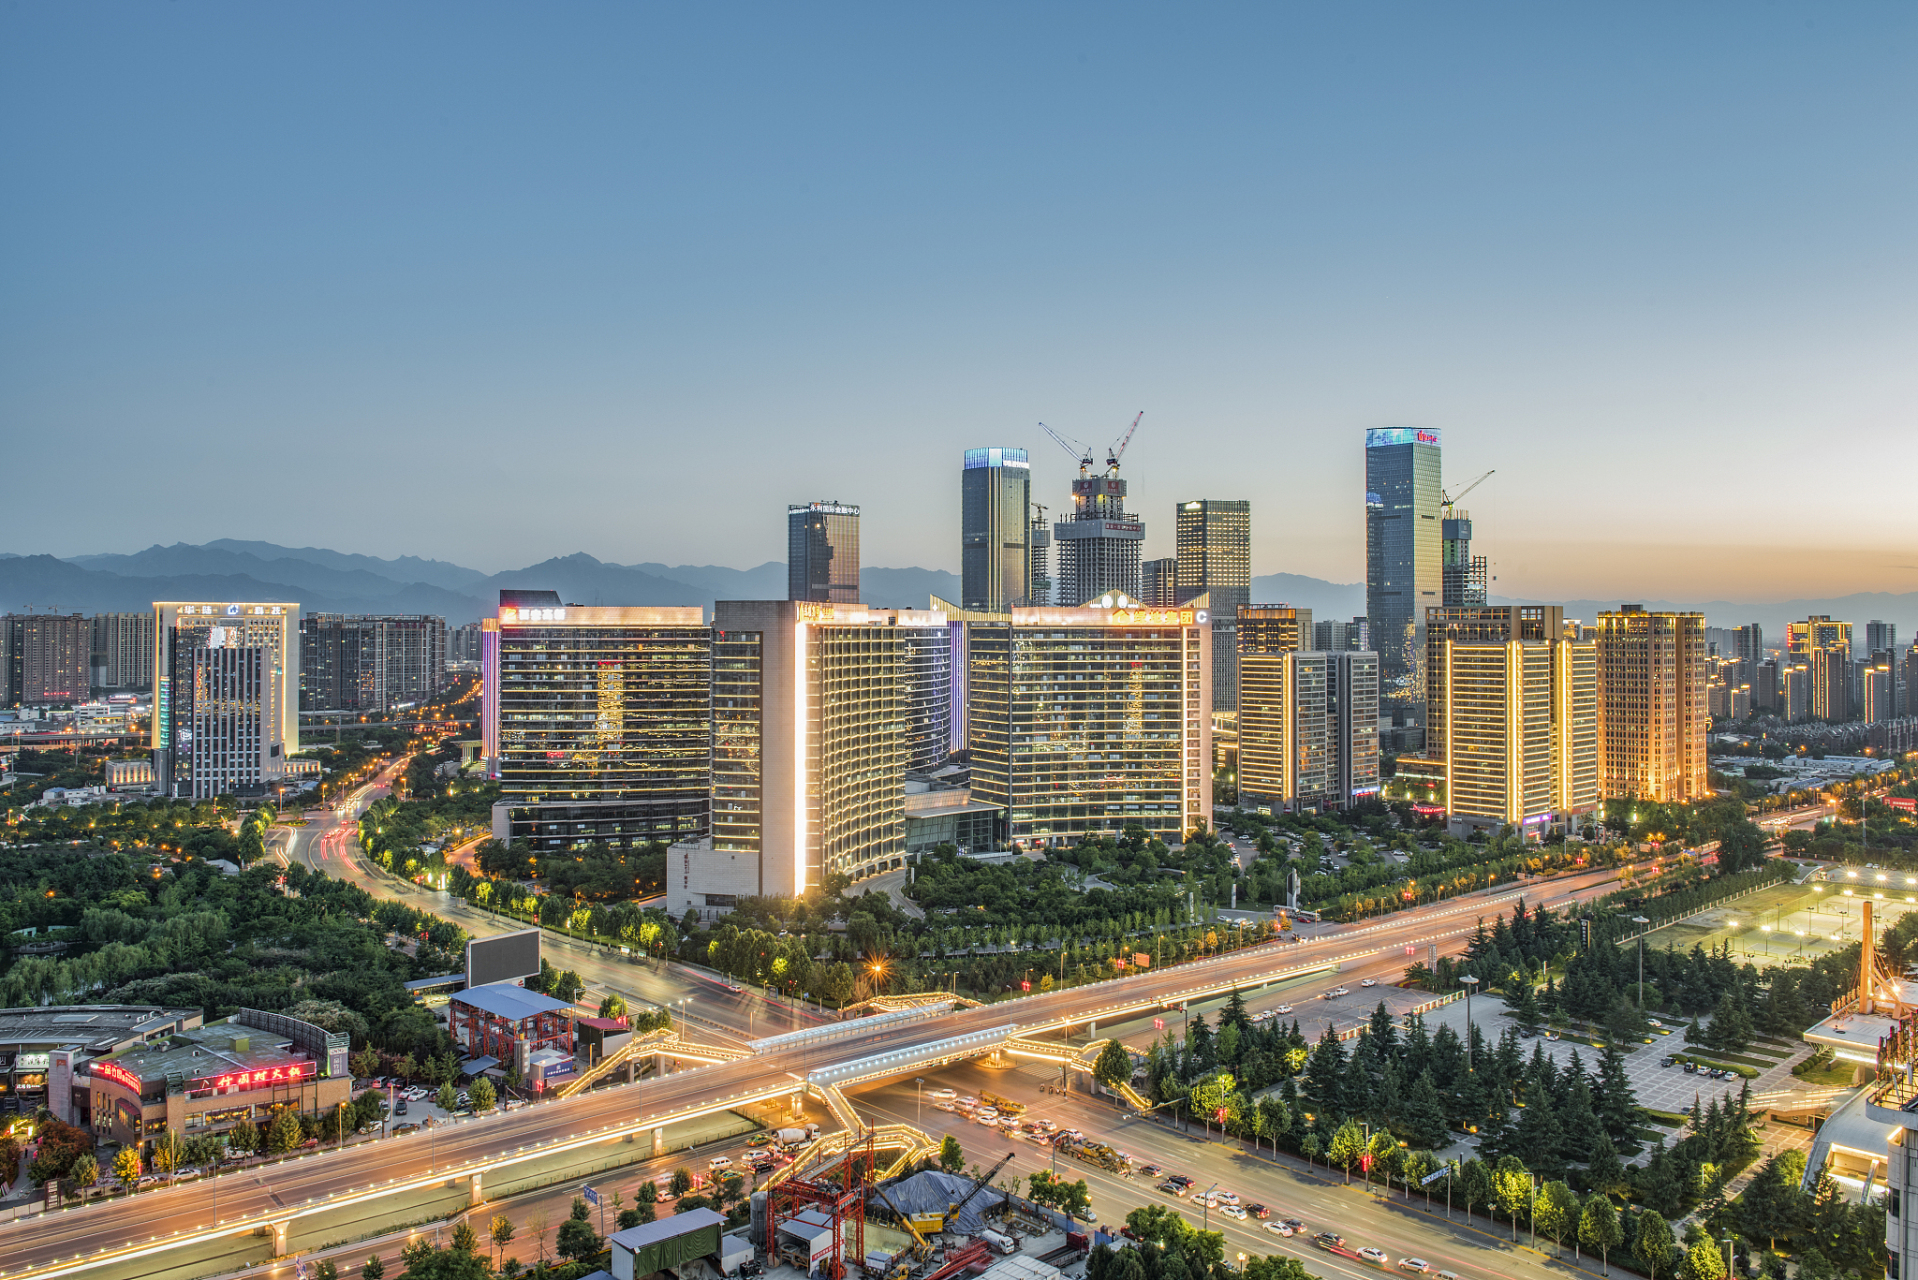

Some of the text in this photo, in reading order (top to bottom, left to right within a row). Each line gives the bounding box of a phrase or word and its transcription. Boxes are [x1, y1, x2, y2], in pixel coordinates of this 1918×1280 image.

[1134, 610, 1193, 625] 绿地集团
[1196, 611, 1207, 623] C
[218, 1067, 300, 1086] 竹园村火锅
